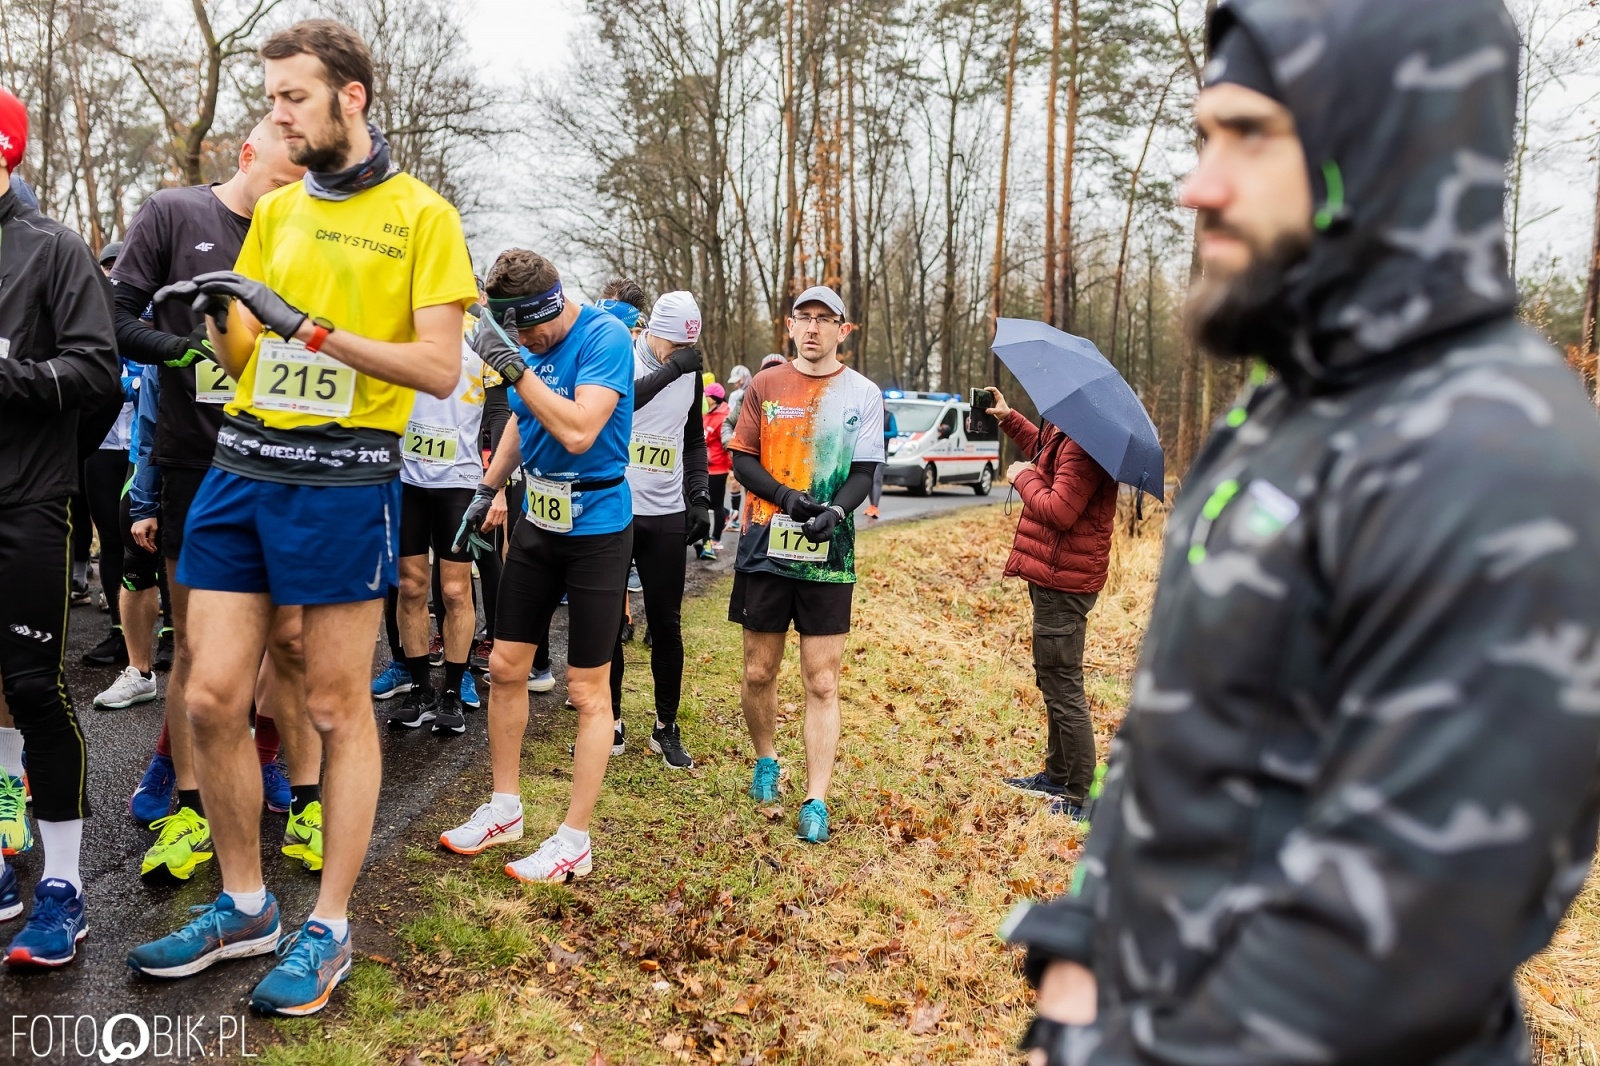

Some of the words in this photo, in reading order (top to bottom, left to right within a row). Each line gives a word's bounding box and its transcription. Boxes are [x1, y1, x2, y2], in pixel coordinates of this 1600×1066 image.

[195, 242, 215, 252] 4F
[211, 364, 230, 391] 2
[269, 363, 337, 400] 215
[260, 445, 317, 462] BIEGAĆ
[411, 435, 446, 458] 211
[636, 445, 670, 467] 170
[530, 490, 561, 521] 218
